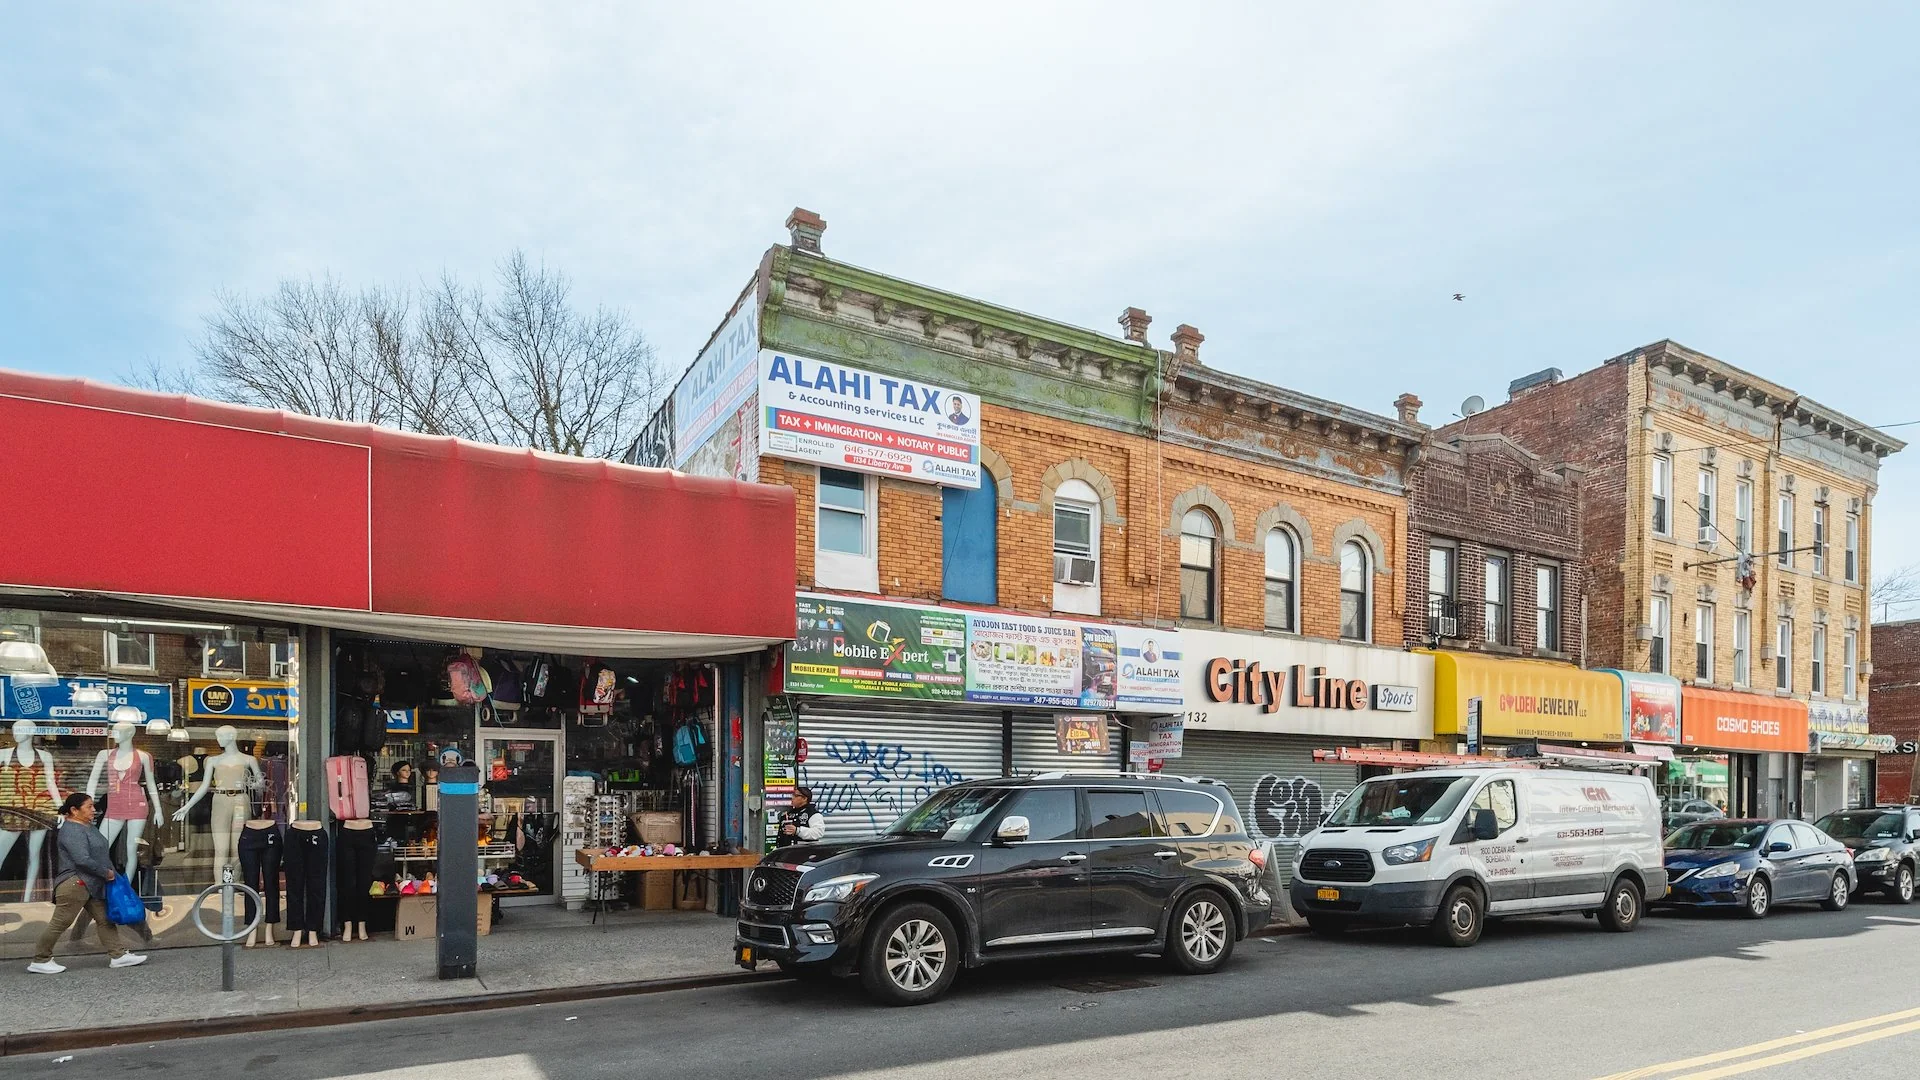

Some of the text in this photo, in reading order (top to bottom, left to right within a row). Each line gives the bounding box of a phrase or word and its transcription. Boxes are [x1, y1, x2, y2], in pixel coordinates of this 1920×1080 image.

[691, 342, 726, 405] ALAHI
[729, 308, 756, 361] TAX
[768, 355, 871, 400] ALAHI
[880, 378, 941, 415] TAX
[788, 391, 925, 426] & Accounting Services LLC
[779, 414, 968, 458] TAX IMMIGRATION NOTARY PUBLIC
[799, 437, 835, 449] ENROLLED
[798, 447, 822, 456] AGENT
[844, 444, 913, 463] 646-577-6929
[852, 456, 904, 471] 1134 Liberty Ave
[935, 464, 960, 475] ALAHI
[961, 468, 977, 478] TAX
[798, 607, 817, 615] REPAIR
[973, 619, 1001, 629] AYOJON
[1001, 622, 1018, 630] FAST
[1019, 623, 1036, 633] FOOD
[1043, 626, 1062, 636] JUICE
[1063, 628, 1076, 637] BAR
[833, 643, 877, 659] Mobile
[793, 664, 837, 674] MOBILE REPAIR
[840, 668, 883, 677] MONEY TRANSFER
[1136, 667, 1180, 678] ALAHI TAX
[882, 680, 899, 688] MOBILE
[934, 675, 962, 683] PHOTOCOPY
[1206, 657, 1368, 713] City Line
[800, 682, 815, 690] Liberty
[1033, 695, 1078, 706] 347-955-6609
[1380, 687, 1413, 708] Sports
[1537, 697, 1579, 717] JEWELRY
[1579, 709, 1587, 718] LLC
[1183, 712, 1207, 723] 132
[1716, 716, 1780, 736] COSMO SHOES
[1560, 804, 1635, 813] Inter-County Mechanical
[1557, 828, 1604, 839] 631-563-1362
[1492, 846, 1507, 854] OCEAN
[1507, 845, 1515, 853] AVE
